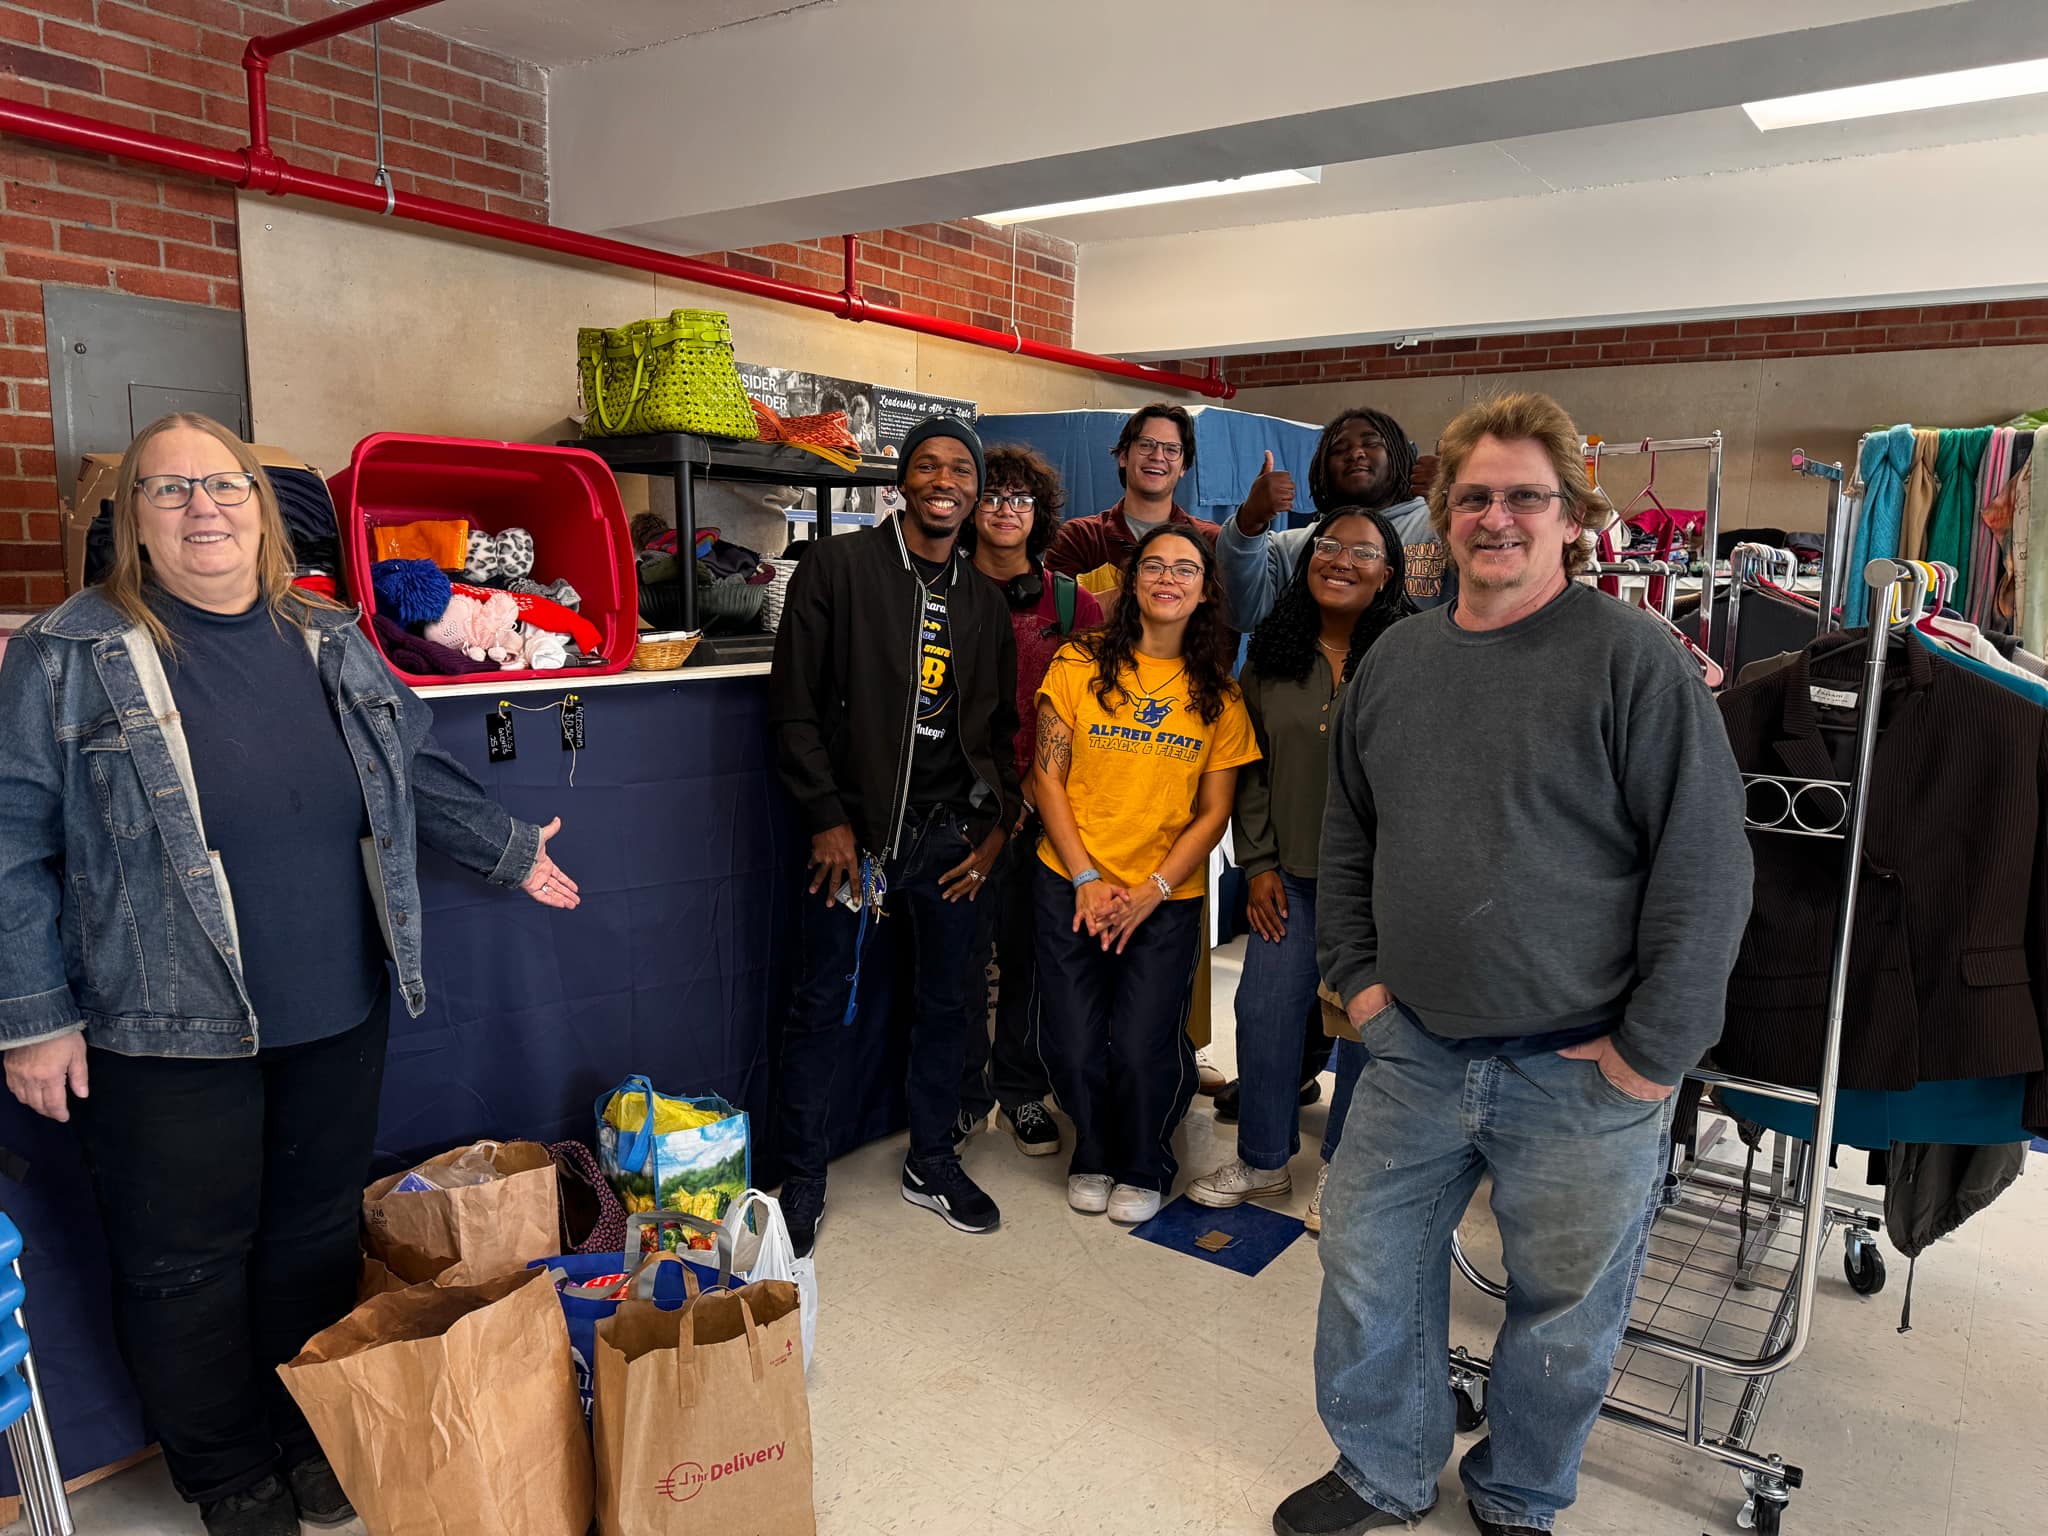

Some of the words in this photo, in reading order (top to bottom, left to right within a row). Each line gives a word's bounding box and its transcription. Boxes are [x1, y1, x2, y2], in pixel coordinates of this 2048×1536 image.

[747, 392, 788, 411] TSIDER
[879, 394, 917, 412] Leadership
[917, 723, 946, 741] Integri
[1088, 724, 1152, 742] ALFRED
[1156, 732, 1203, 751] STATE
[1089, 736, 1140, 754] TRACK
[1142, 743, 1152, 755] &
[1155, 744, 1199, 764] FIELD
[691, 1471, 708, 1484] 1hr
[710, 1440, 785, 1482] Delivery
